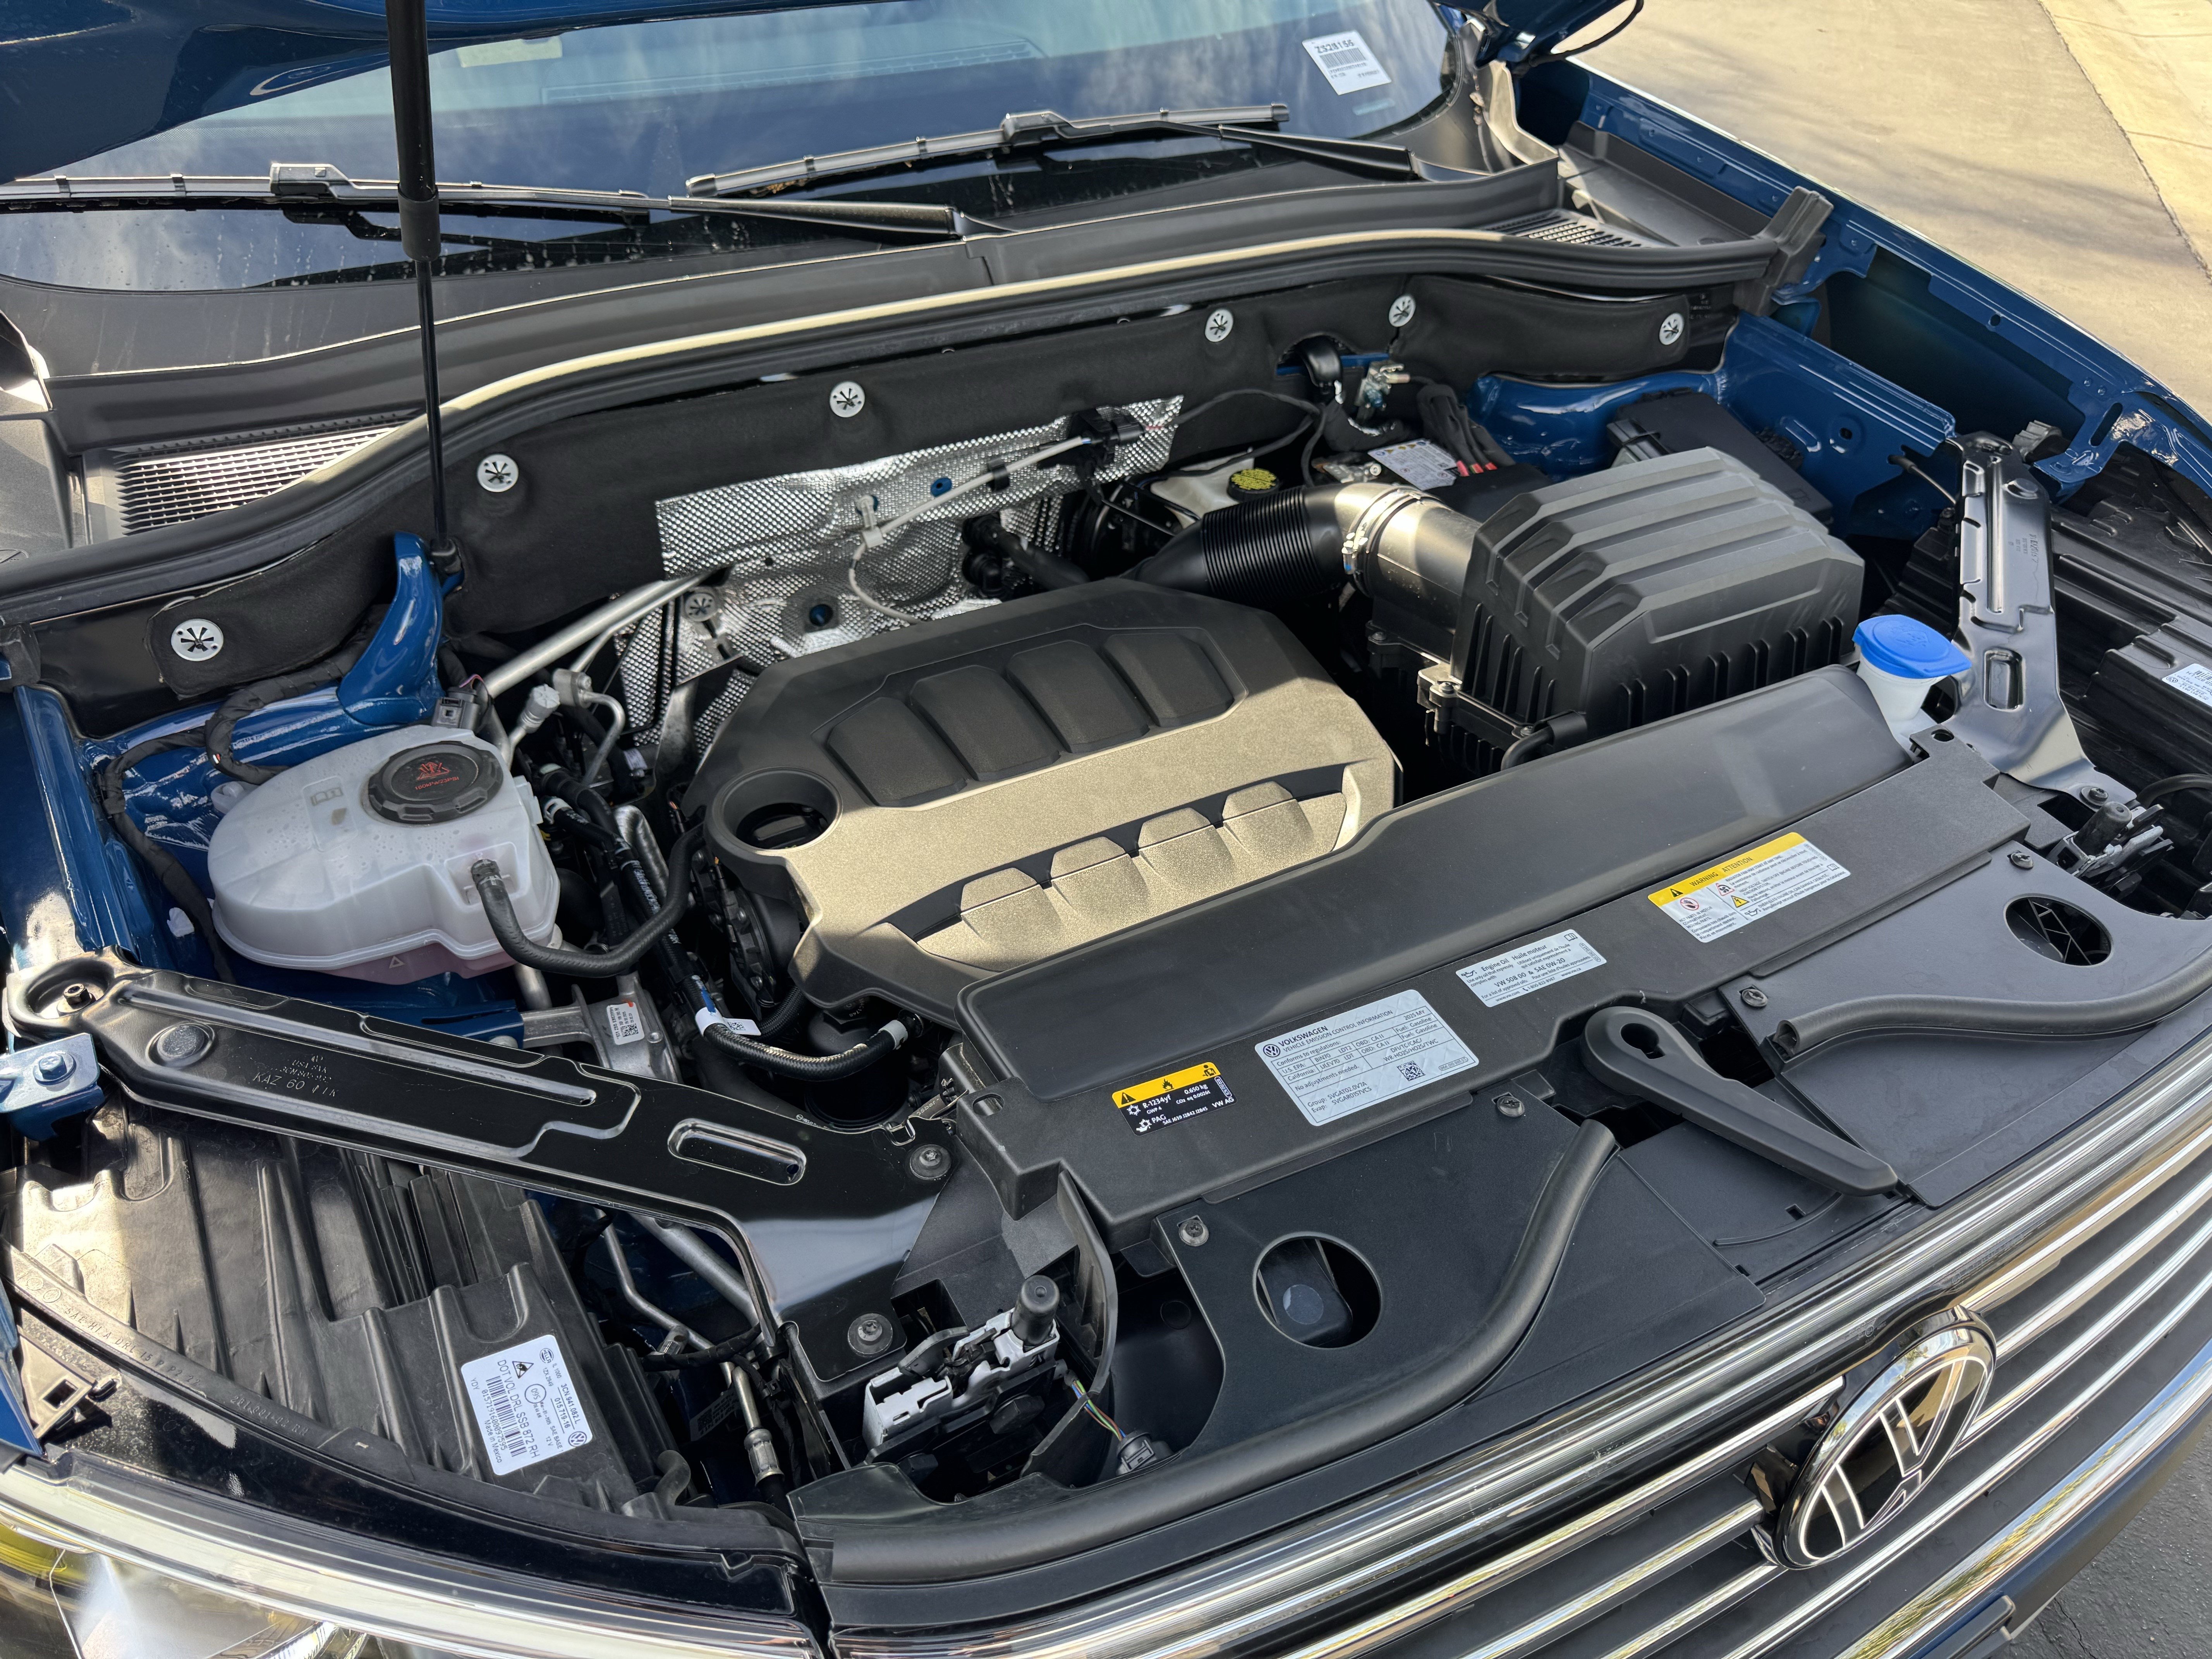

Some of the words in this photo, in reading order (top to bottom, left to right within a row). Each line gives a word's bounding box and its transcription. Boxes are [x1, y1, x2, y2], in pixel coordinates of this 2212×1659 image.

[1688, 872, 1719, 886] WARNING
[1720, 856, 1753, 872] ATTENTION
[1511, 952, 1527, 960] Huile
[1526, 945, 1547, 955] moteur
[1530, 949, 1555, 960] uniquement
[1480, 961, 1502, 972] Engine
[1496, 964, 1515, 972] expressly
[1527, 958, 1543, 966] satisfait
[1545, 957, 1566, 968] 0W-20
[1561, 967, 1582, 977] www.vw.ca
[1470, 978, 1488, 987] complies
[1501, 981, 1521, 991] approved
[1495, 991, 1520, 1002] www.vw.com
[1278, 1025, 1328, 1047] VOLKSWAGEN
[1283, 1041, 1306, 1053] VEHICLE
[1305, 1032, 1332, 1044] EMISSION
[1331, 1022, 1357, 1035] CONTROL
[1356, 1009, 1393, 1026] INFORMATION
[1293, 1062, 1306, 1070] EPA:
[1314, 1053, 1331, 1062] BIN70
[1338, 1045, 1352, 1053] LDT2
[1355, 1039, 1370, 1047] OBD:
[1409, 1016, 1432, 1028] Gasoline
[1383, 1038, 1439, 1062] WR-HO2S/HO2S/TWC
[1390, 1037, 1423, 1053] DFI/TC/CAC/
[1276, 1053, 1303, 1067] Conforms
[1309, 1040, 1342, 1056] regulations:
[1287, 1067, 1316, 1081] California:
[1319, 1058, 1341, 1069] ULEV70
[1360, 1046, 1376, 1054] OBD:
[1415, 1023, 1437, 1034] Gasoline
[253, 1072, 282, 1085] KAZ
[286, 1079, 305, 1090] 60
[1304, 1072, 1339, 1089] adjustments
[1337, 1064, 1359, 1075] needed.
[1183, 1085, 1200, 1094] 0.650
[1192, 1090, 1211, 1099] 0.0026t
[1142, 1094, 1173, 1110] R-1234yf
[1211, 1100, 1224, 1108] VW
[1307, 1096, 1328, 1108] Group:
[1311, 1103, 1328, 1113] Evap:
[1151, 1114, 1166, 1123] PAG
[64, 1308, 88, 1325] SAE
[114, 1336, 134, 1353] DRL
[167, 1365, 182, 1376] P2
[543, 1349, 551, 1363] HELLA
[497, 1359, 511, 1378] DOT
[554, 1368, 562, 1379] 1000
[470, 1377, 479, 1391] YDY
[503, 1376, 517, 1394] VOL
[509, 1394, 523, 1412] DRL
[560, 1383, 581, 1424] 3CN.941.082.L
[515, 1411, 529, 1429] SSB
[554, 1397, 570, 1429] 015.719-16
[483, 1419, 495, 1436] Made
[491, 1442, 504, 1463] Mexico
[522, 1428, 534, 1444] 872
[553, 1435, 562, 1449] BASE
[527, 1444, 540, 1458] RH
